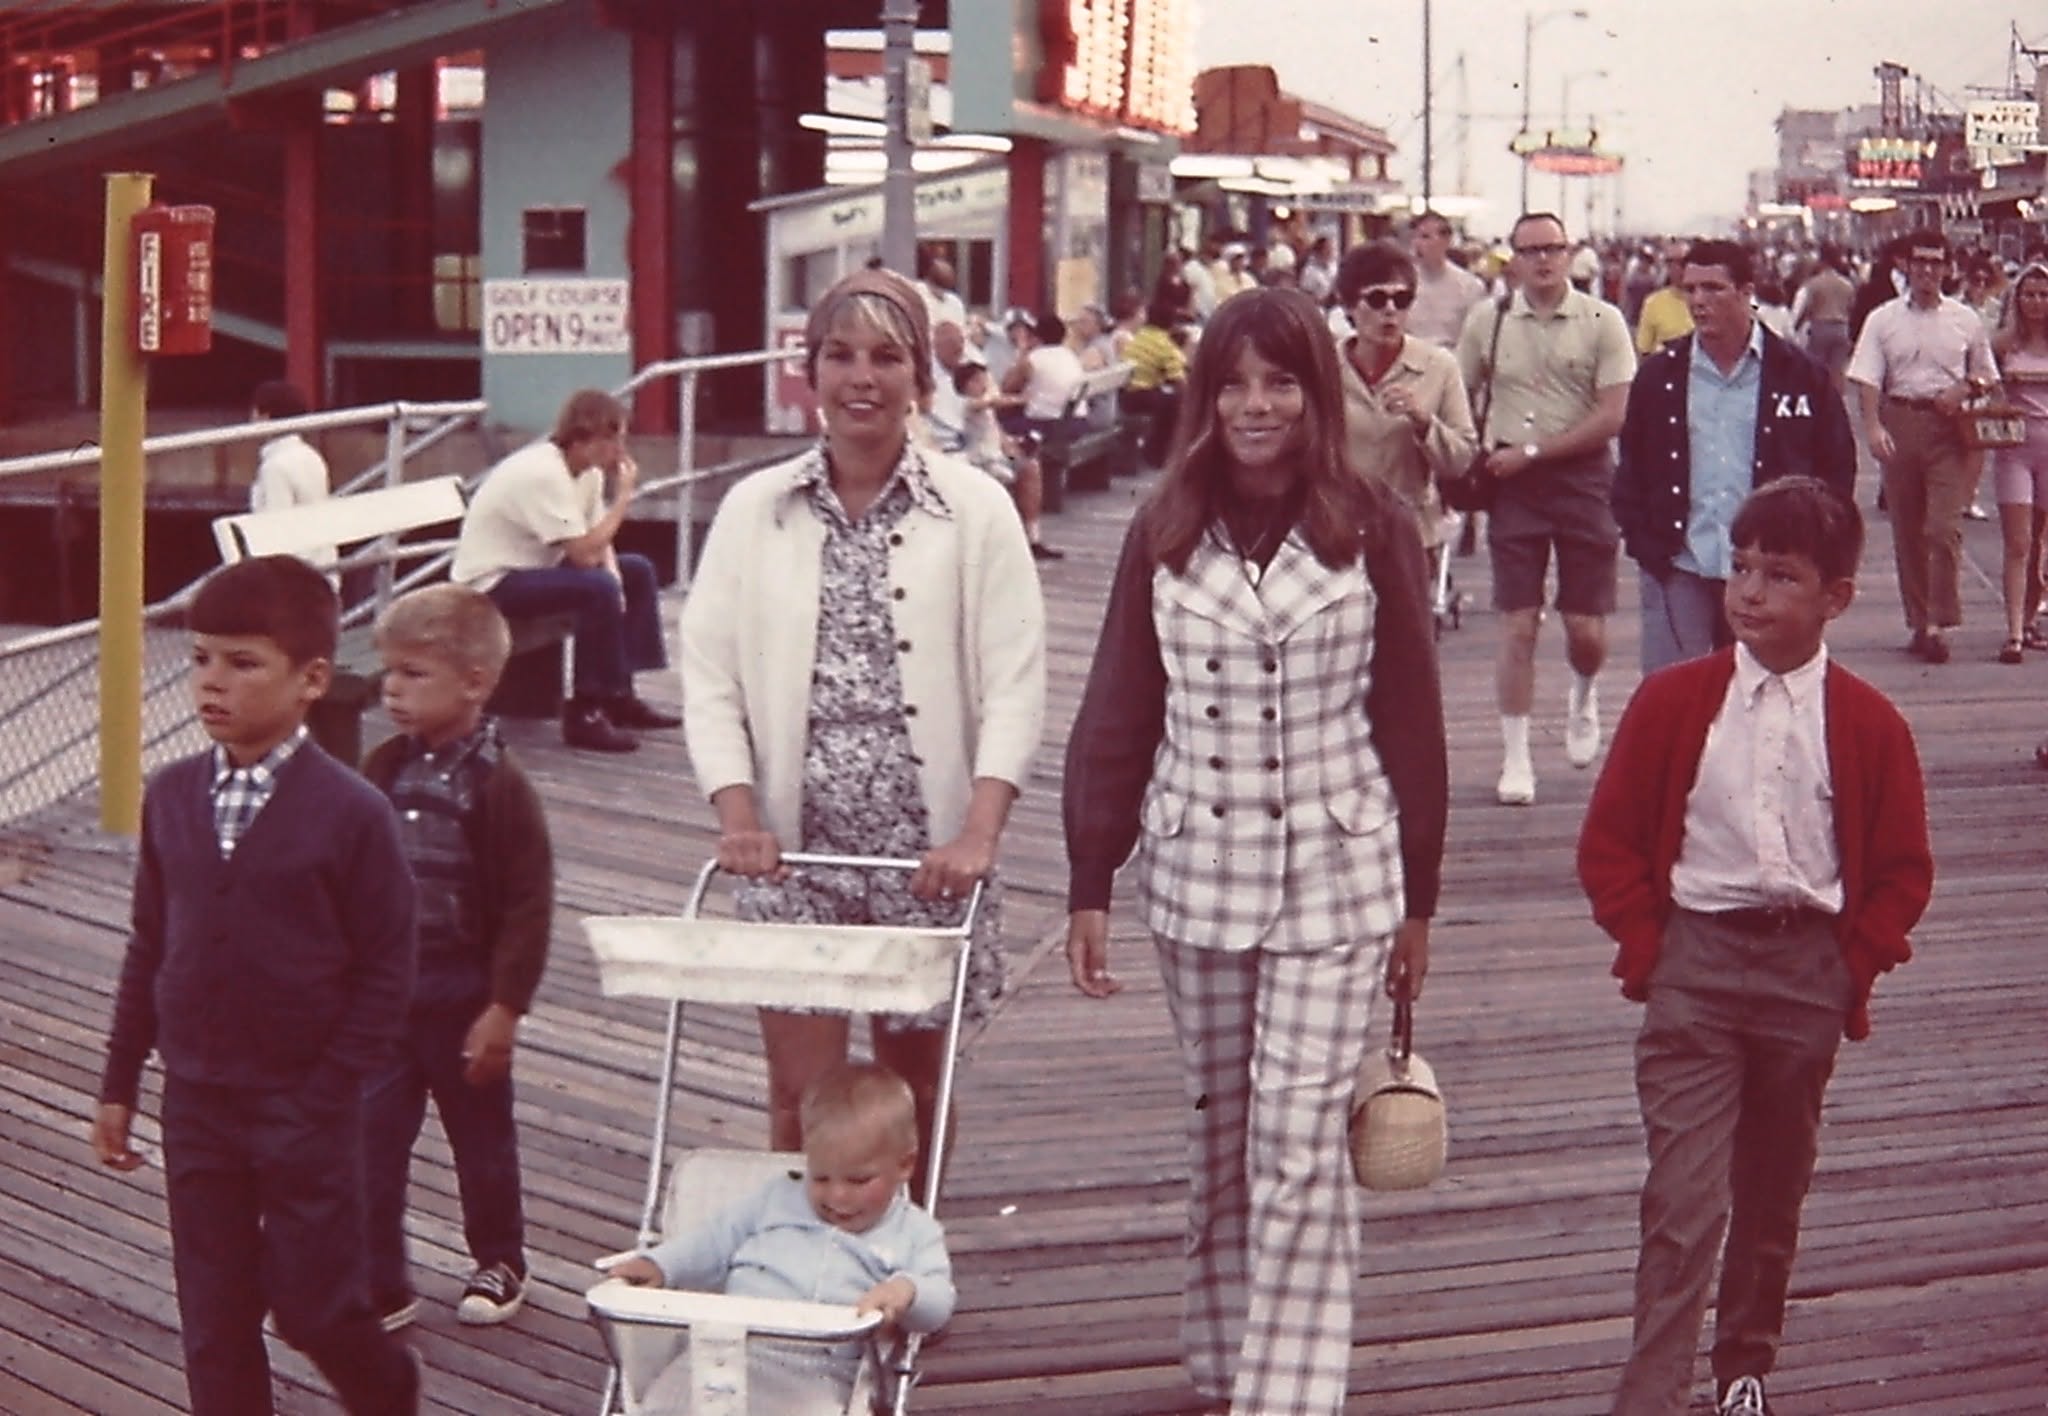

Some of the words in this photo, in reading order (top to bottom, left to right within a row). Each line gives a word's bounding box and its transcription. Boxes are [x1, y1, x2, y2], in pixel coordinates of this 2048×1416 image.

[1973, 112, 2039, 127] WAFFL
[1858, 160, 1922, 178] PIZZA
[493, 312, 562, 346] OPEN
[567, 312, 584, 346] 9
